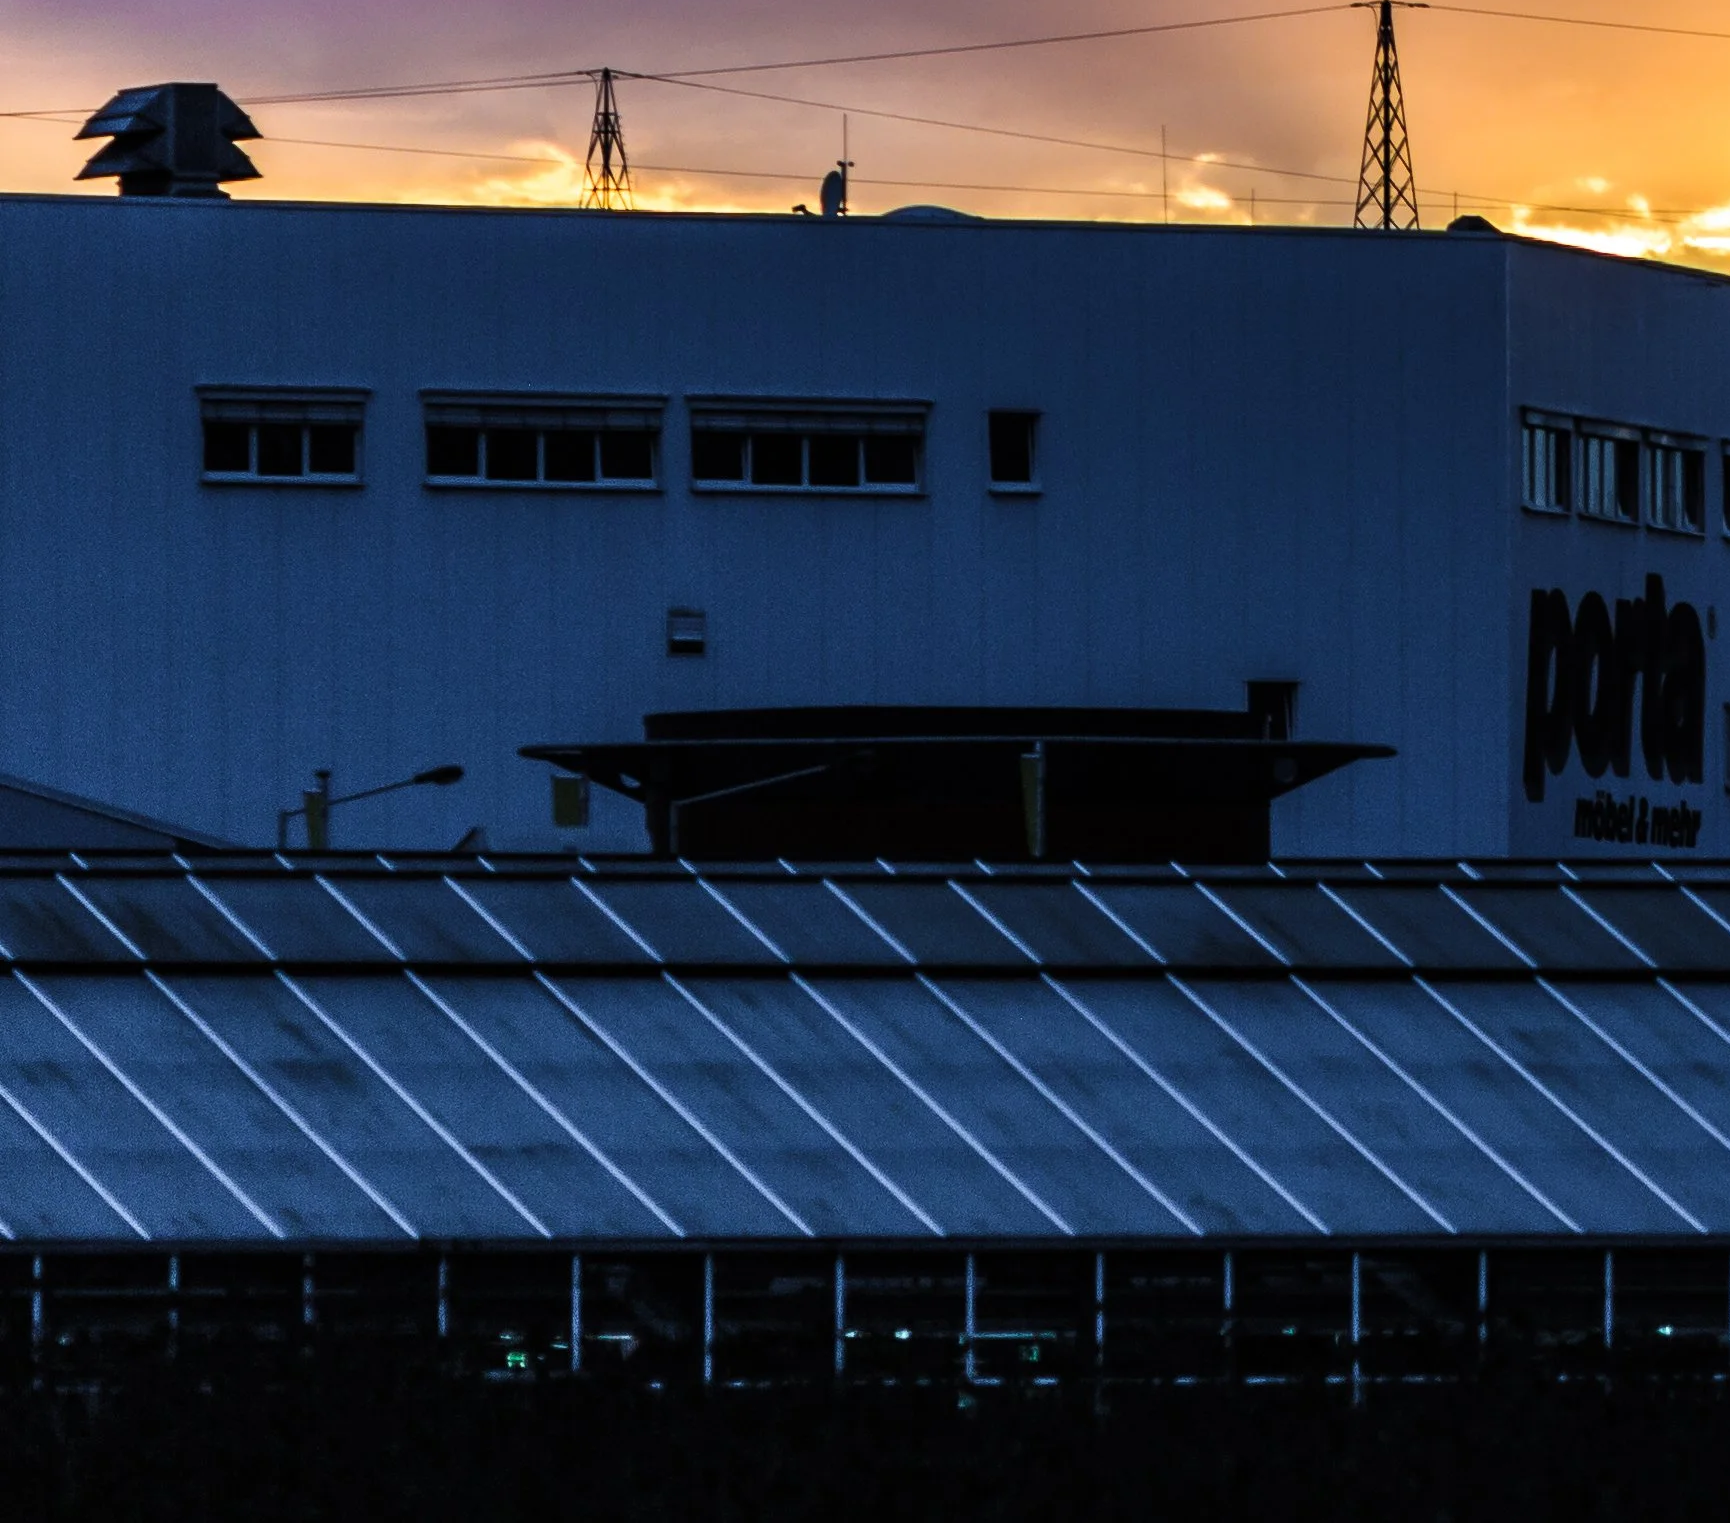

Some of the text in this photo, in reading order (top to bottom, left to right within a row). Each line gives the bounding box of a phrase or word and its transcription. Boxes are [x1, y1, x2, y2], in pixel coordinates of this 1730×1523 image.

[1523, 573, 1706, 803] porta
[1575, 790, 1702, 849] möbel & mehr
